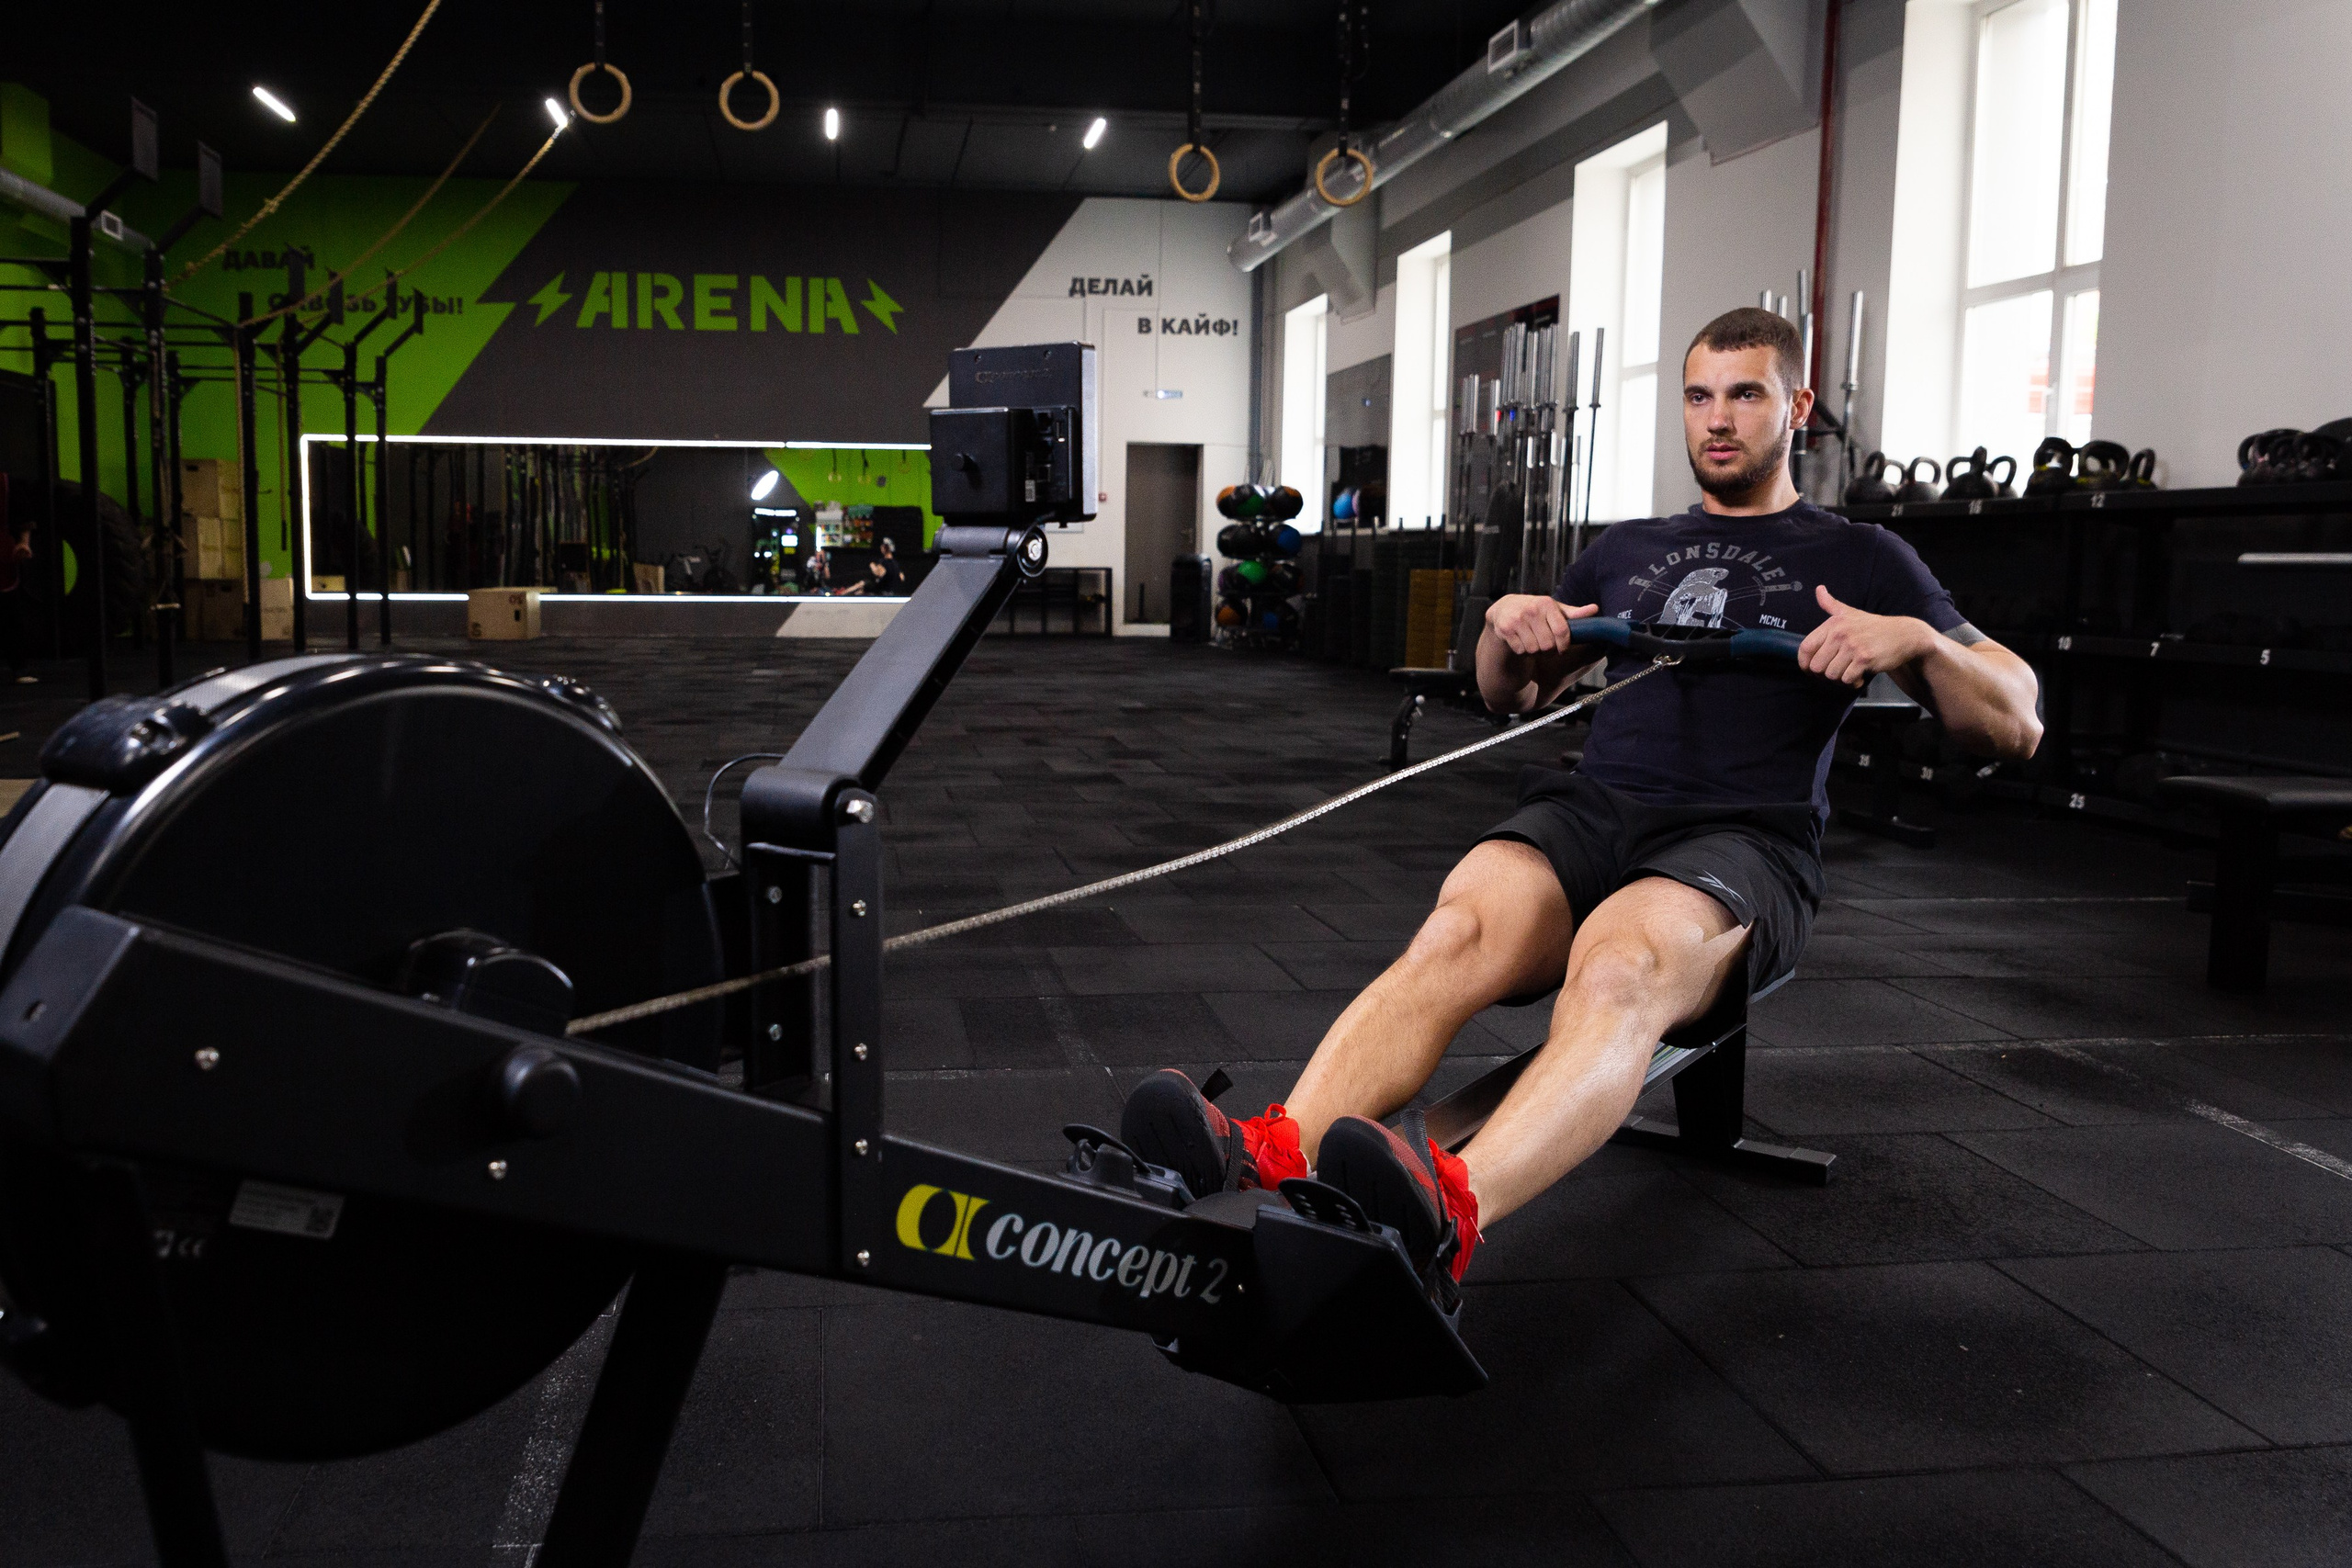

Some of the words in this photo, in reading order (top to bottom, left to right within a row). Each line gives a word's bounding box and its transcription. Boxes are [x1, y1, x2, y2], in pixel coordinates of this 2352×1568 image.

[1069, 275, 1153, 298] ДЕЛАЙ
[576, 271, 860, 334] ARENA
[1137, 318, 1152, 334] В
[1161, 313, 1239, 336] КАЙФ!
[2090, 492, 2106, 508] 12
[1648, 542, 1786, 581] LONSDALE
[1758, 614, 1787, 629] MCMLX
[2150, 641, 2161, 657] 7
[2260, 649, 2271, 665] 5
[2068, 793, 2086, 809] 25
[986, 1213, 1198, 1298] concept
[1200, 1258, 1228, 1304] 2
